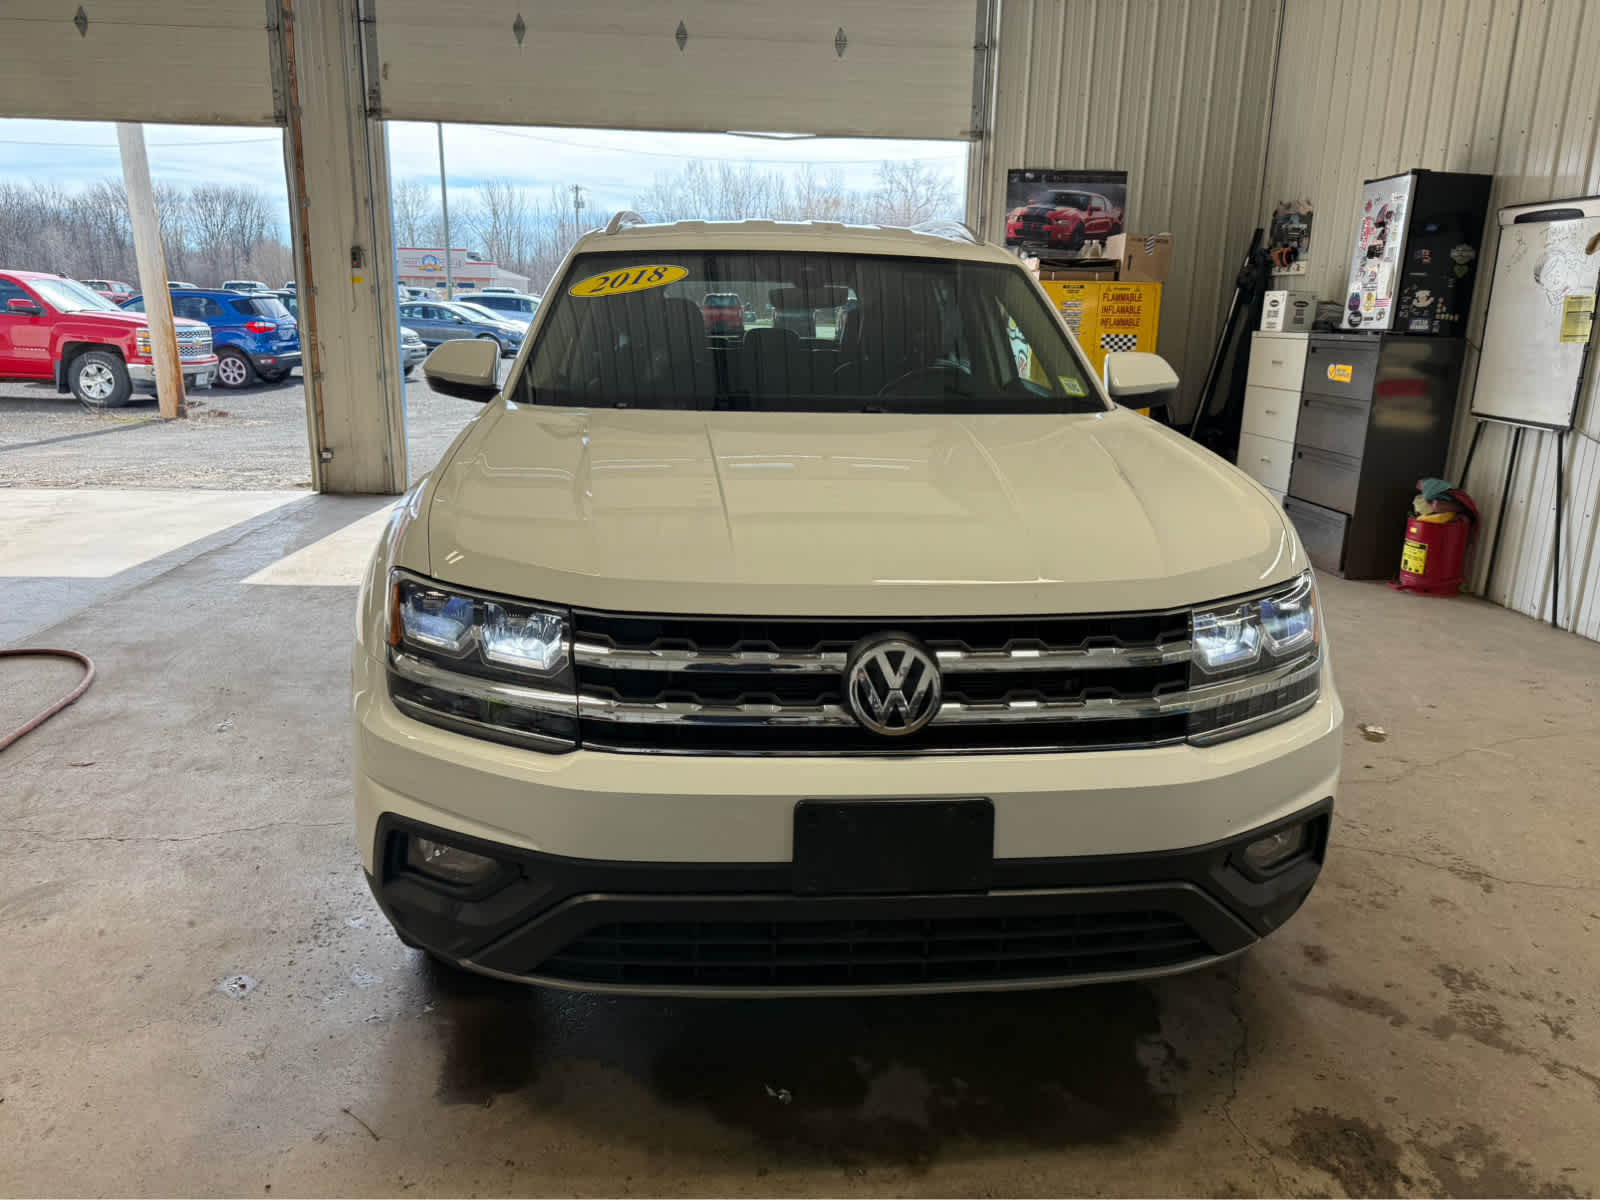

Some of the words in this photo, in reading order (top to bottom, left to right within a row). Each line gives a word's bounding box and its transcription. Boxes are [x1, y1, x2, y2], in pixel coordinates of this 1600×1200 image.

[590, 266, 668, 293] 2018
[1103, 293, 1143, 302] FLAMMABLE
[852, 643, 938, 733] VW
